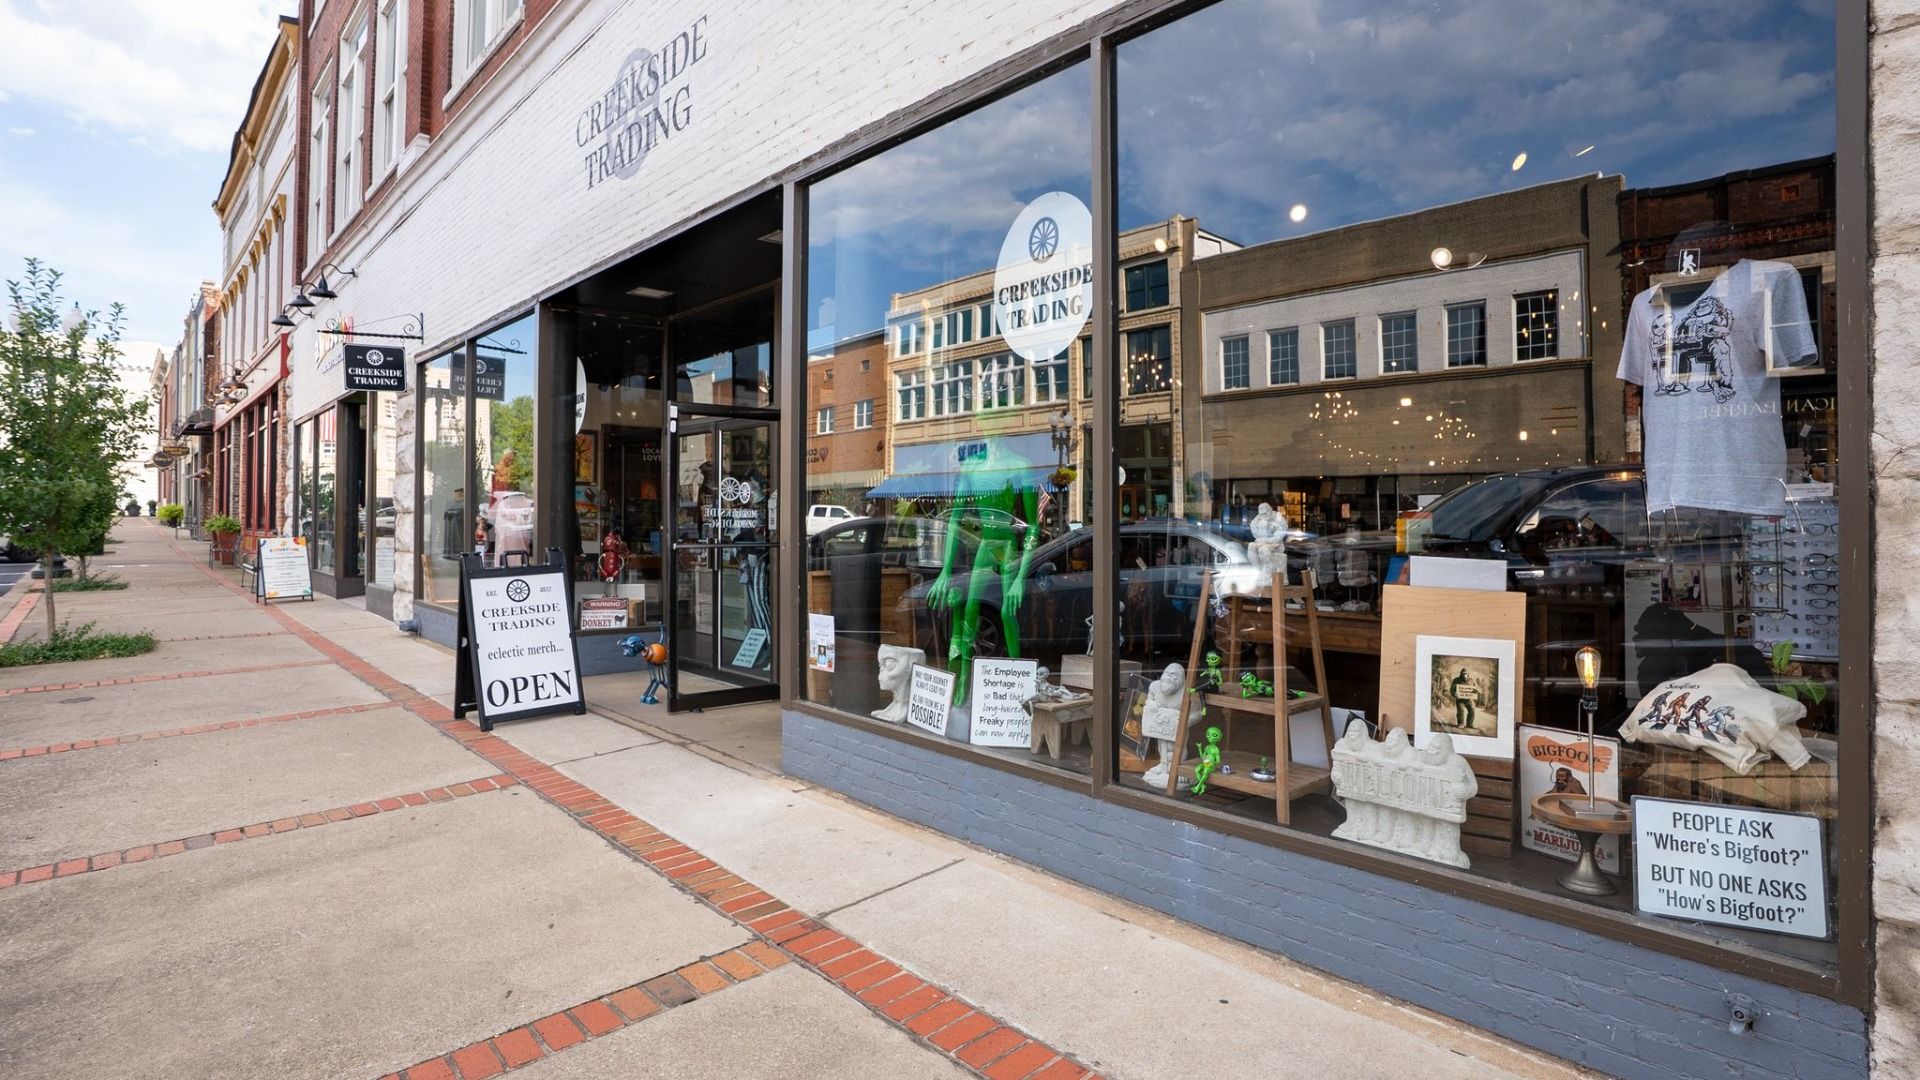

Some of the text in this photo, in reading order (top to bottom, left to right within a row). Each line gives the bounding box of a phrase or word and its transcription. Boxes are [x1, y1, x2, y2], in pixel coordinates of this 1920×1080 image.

[576, 14, 708, 147] CREEKSIDE
[585, 84, 693, 190] TRADING
[999, 263, 1093, 305] CREEKSIDE
[1006, 295, 1083, 330] TRADING
[348, 367, 403, 377] CREEKSIDE
[354, 376, 398, 386] TRADING
[481, 602, 561, 618] CREEKSIDE
[489, 616, 556, 632] TRADING
[582, 619, 613, 627] DONKEY
[488, 641, 564, 661] eclectic merch...
[981, 665, 1031, 677] The Employee
[487, 670, 572, 708] OPEN
[983, 680, 1024, 689] Shortage is
[993, 691, 1007, 700] Bad
[911, 703, 944, 730] POSSIBLE!
[979, 716, 1029, 728] Freaky people
[975, 729, 988, 737] can
[1343, 760, 1455, 810] WELCOME
[1672, 812, 1775, 839] PEOPLE ASK
[1646, 831, 1809, 866] "Where's Bigfoot?"
[1651, 864, 1807, 901] BUT NO ONE ASKS
[1658, 888, 1805, 923] "How's Bigfoot?"
